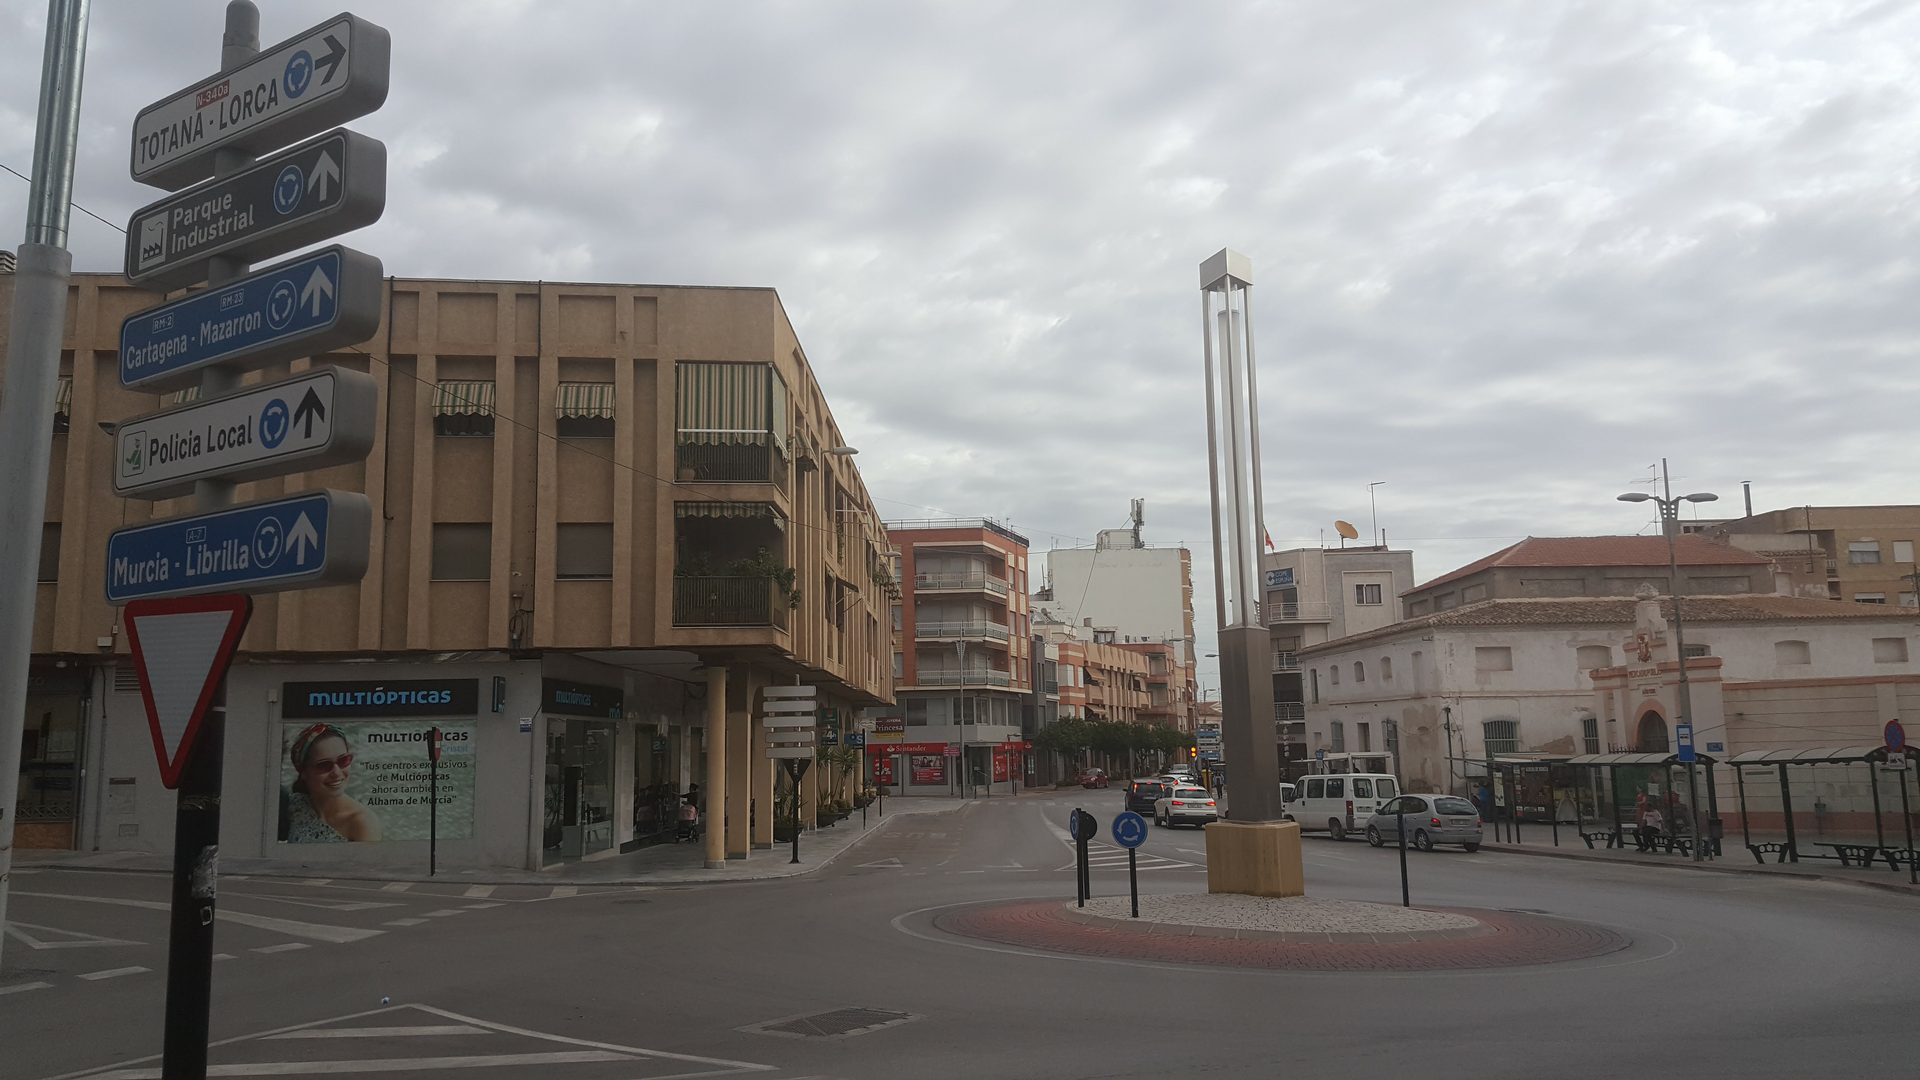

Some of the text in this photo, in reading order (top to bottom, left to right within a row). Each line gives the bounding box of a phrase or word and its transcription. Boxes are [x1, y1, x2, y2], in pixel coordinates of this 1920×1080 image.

[196, 82, 229, 106] N-340a
[140, 112, 204, 164] TOTANA
[219, 79, 278, 130] LORCA
[173, 193, 233, 229] Parque
[171, 204, 255, 254] Industrial
[154, 315, 172, 331] RM-2
[126, 335, 188, 370] Cartagena
[200, 311, 262, 346] Mazarron
[207, 415, 253, 453] Local
[188, 528, 204, 542] A-7
[113, 551, 169, 587] Murcia
[185, 538, 250, 577] Librilla
[895, 744, 928, 752] Santander
[382, 761, 417, 770] centros
[419, 760, 468, 769] exusivos
[376, 773, 450, 783] de Multióptcas
[371, 785, 398, 794] ahora
[442, 785, 454, 793] en
[367, 797, 404, 806] Alhama
[406, 796, 418, 805] de
